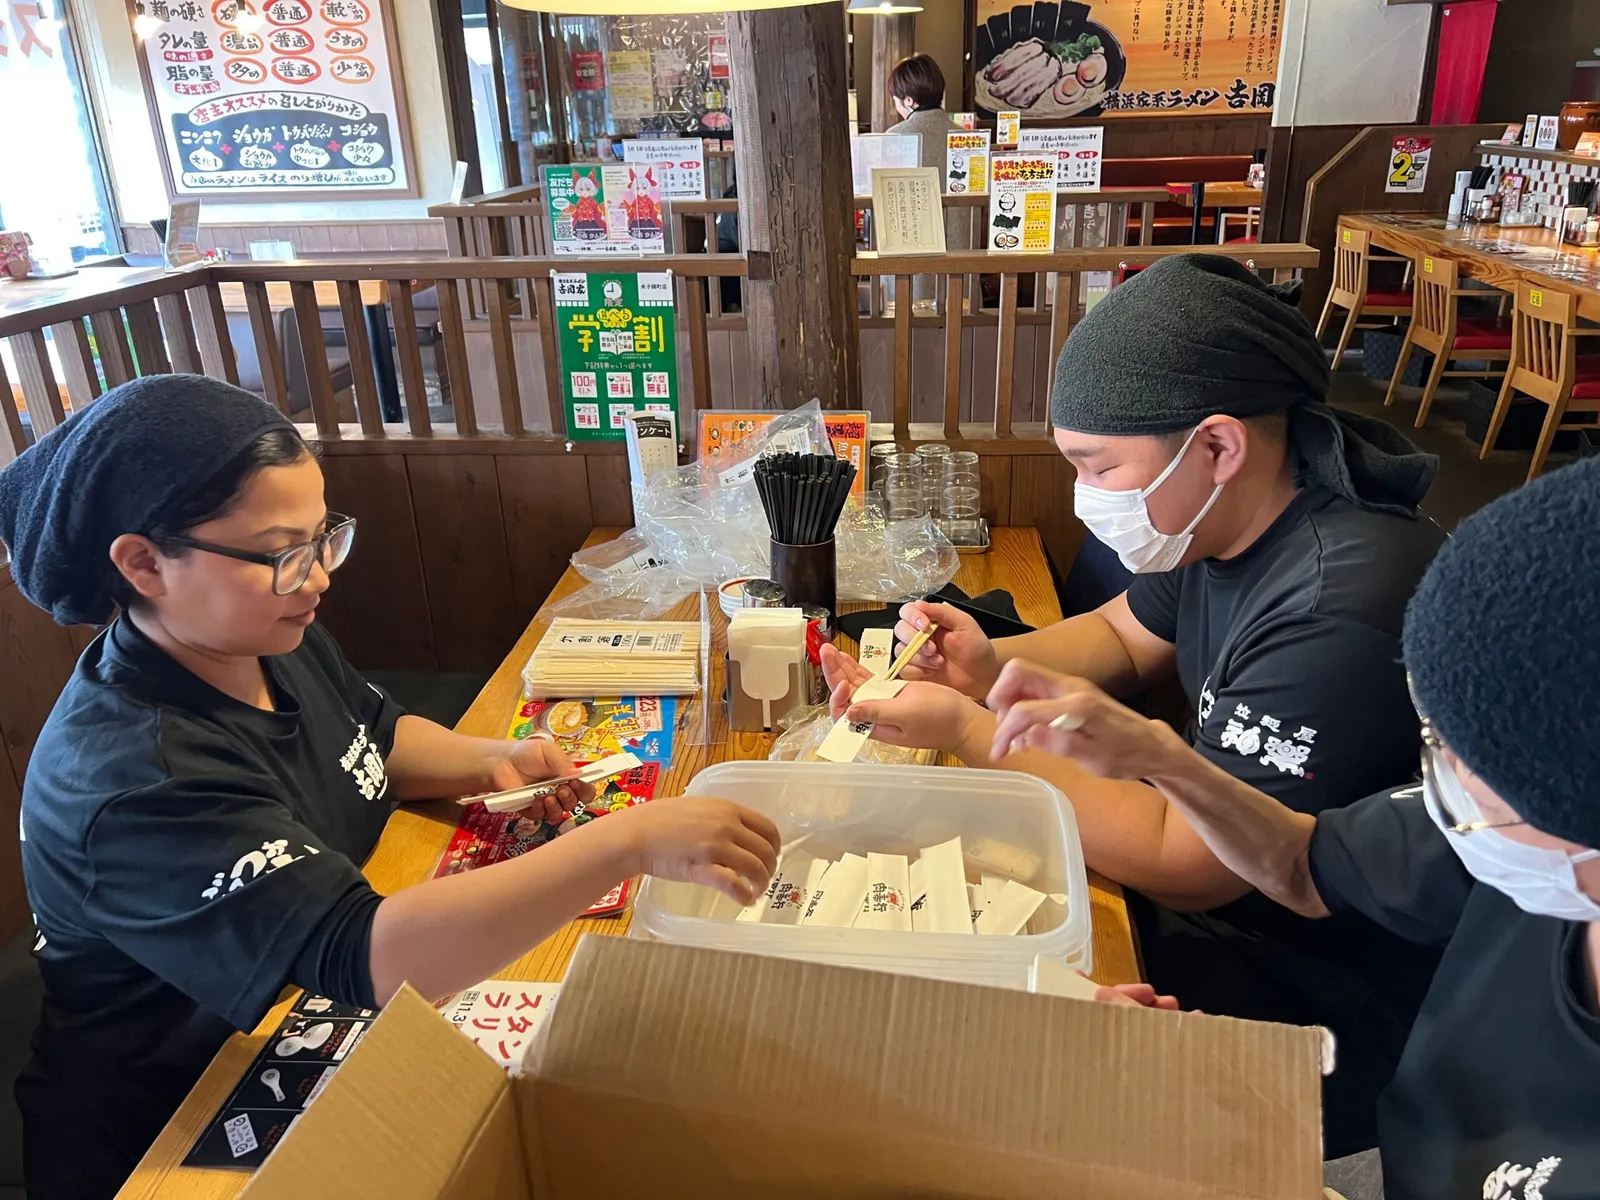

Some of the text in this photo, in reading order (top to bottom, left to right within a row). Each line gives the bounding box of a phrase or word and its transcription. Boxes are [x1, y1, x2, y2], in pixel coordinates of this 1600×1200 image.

[272, 3, 306, 20] 普通
[1163, 0, 1173, 51] な豚骨の旨みが
[1173, 0, 1184, 57] タージュのような
[158, 31, 209, 49] タレの量
[274, 31, 308, 48] 普通
[329, 32, 363, 47] うすめ
[166, 61, 369, 82] 脂の量 多め 普通 少なめ
[1104, 88, 1220, 110] 横浜家系ラーメン
[180, 129, 223, 145] ニンニク
[232, 123, 276, 144] ショウガ
[340, 123, 379, 138] コショウ
[347, 144, 375, 154] コショウ
[353, 153, 372, 163] 少々
[1390, 151, 1413, 182] 2
[1233, 703, 1317, 743] 拉麺屋
[472, 992, 511, 1045] ラリ
[498, 992, 542, 1072] スタン
